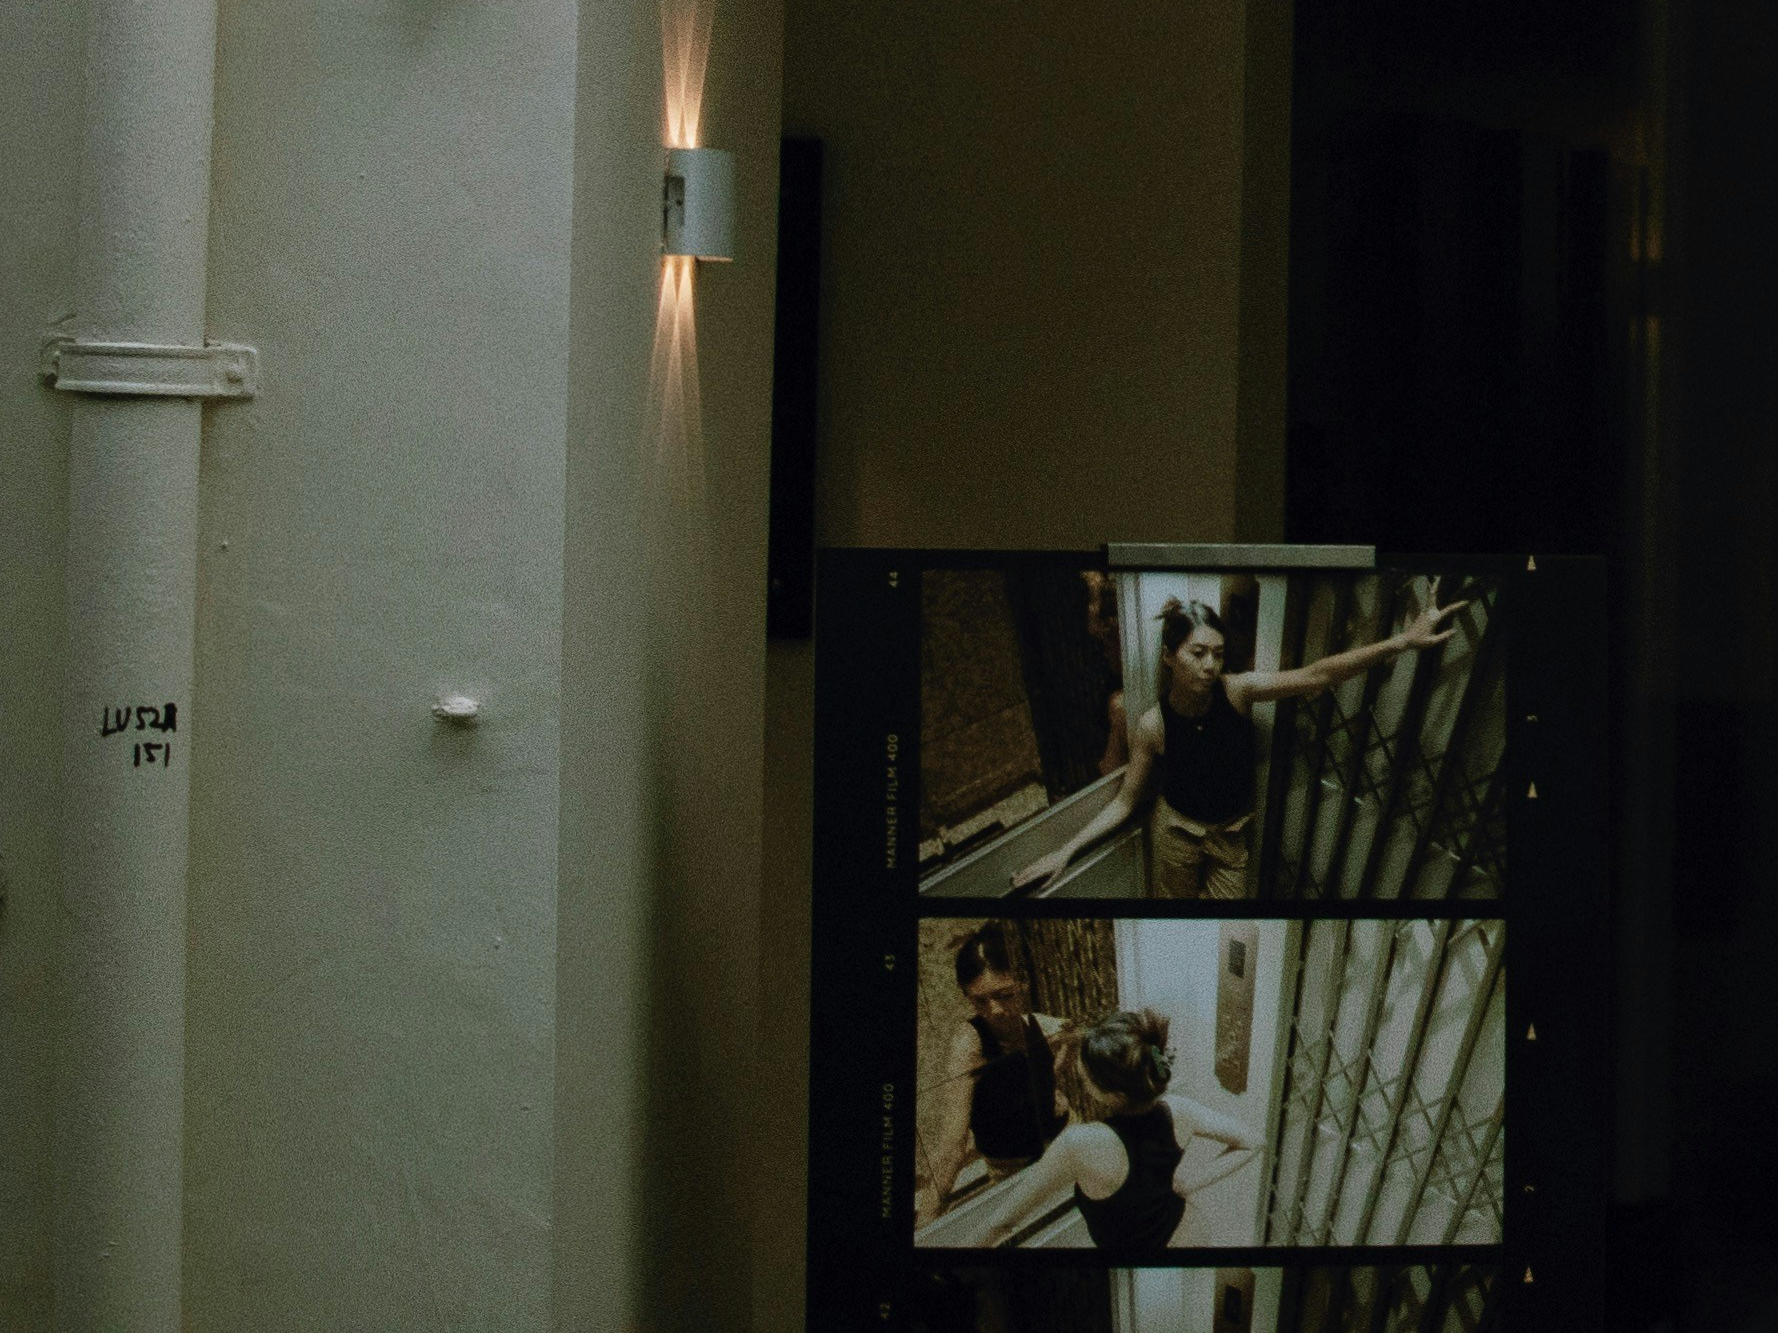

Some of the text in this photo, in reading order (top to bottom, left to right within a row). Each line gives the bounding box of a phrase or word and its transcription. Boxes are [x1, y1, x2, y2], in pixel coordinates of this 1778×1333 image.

[886, 733, 899, 870] MANNER FILM 400
[881, 1082, 895, 1219] MANNER FILM 400
